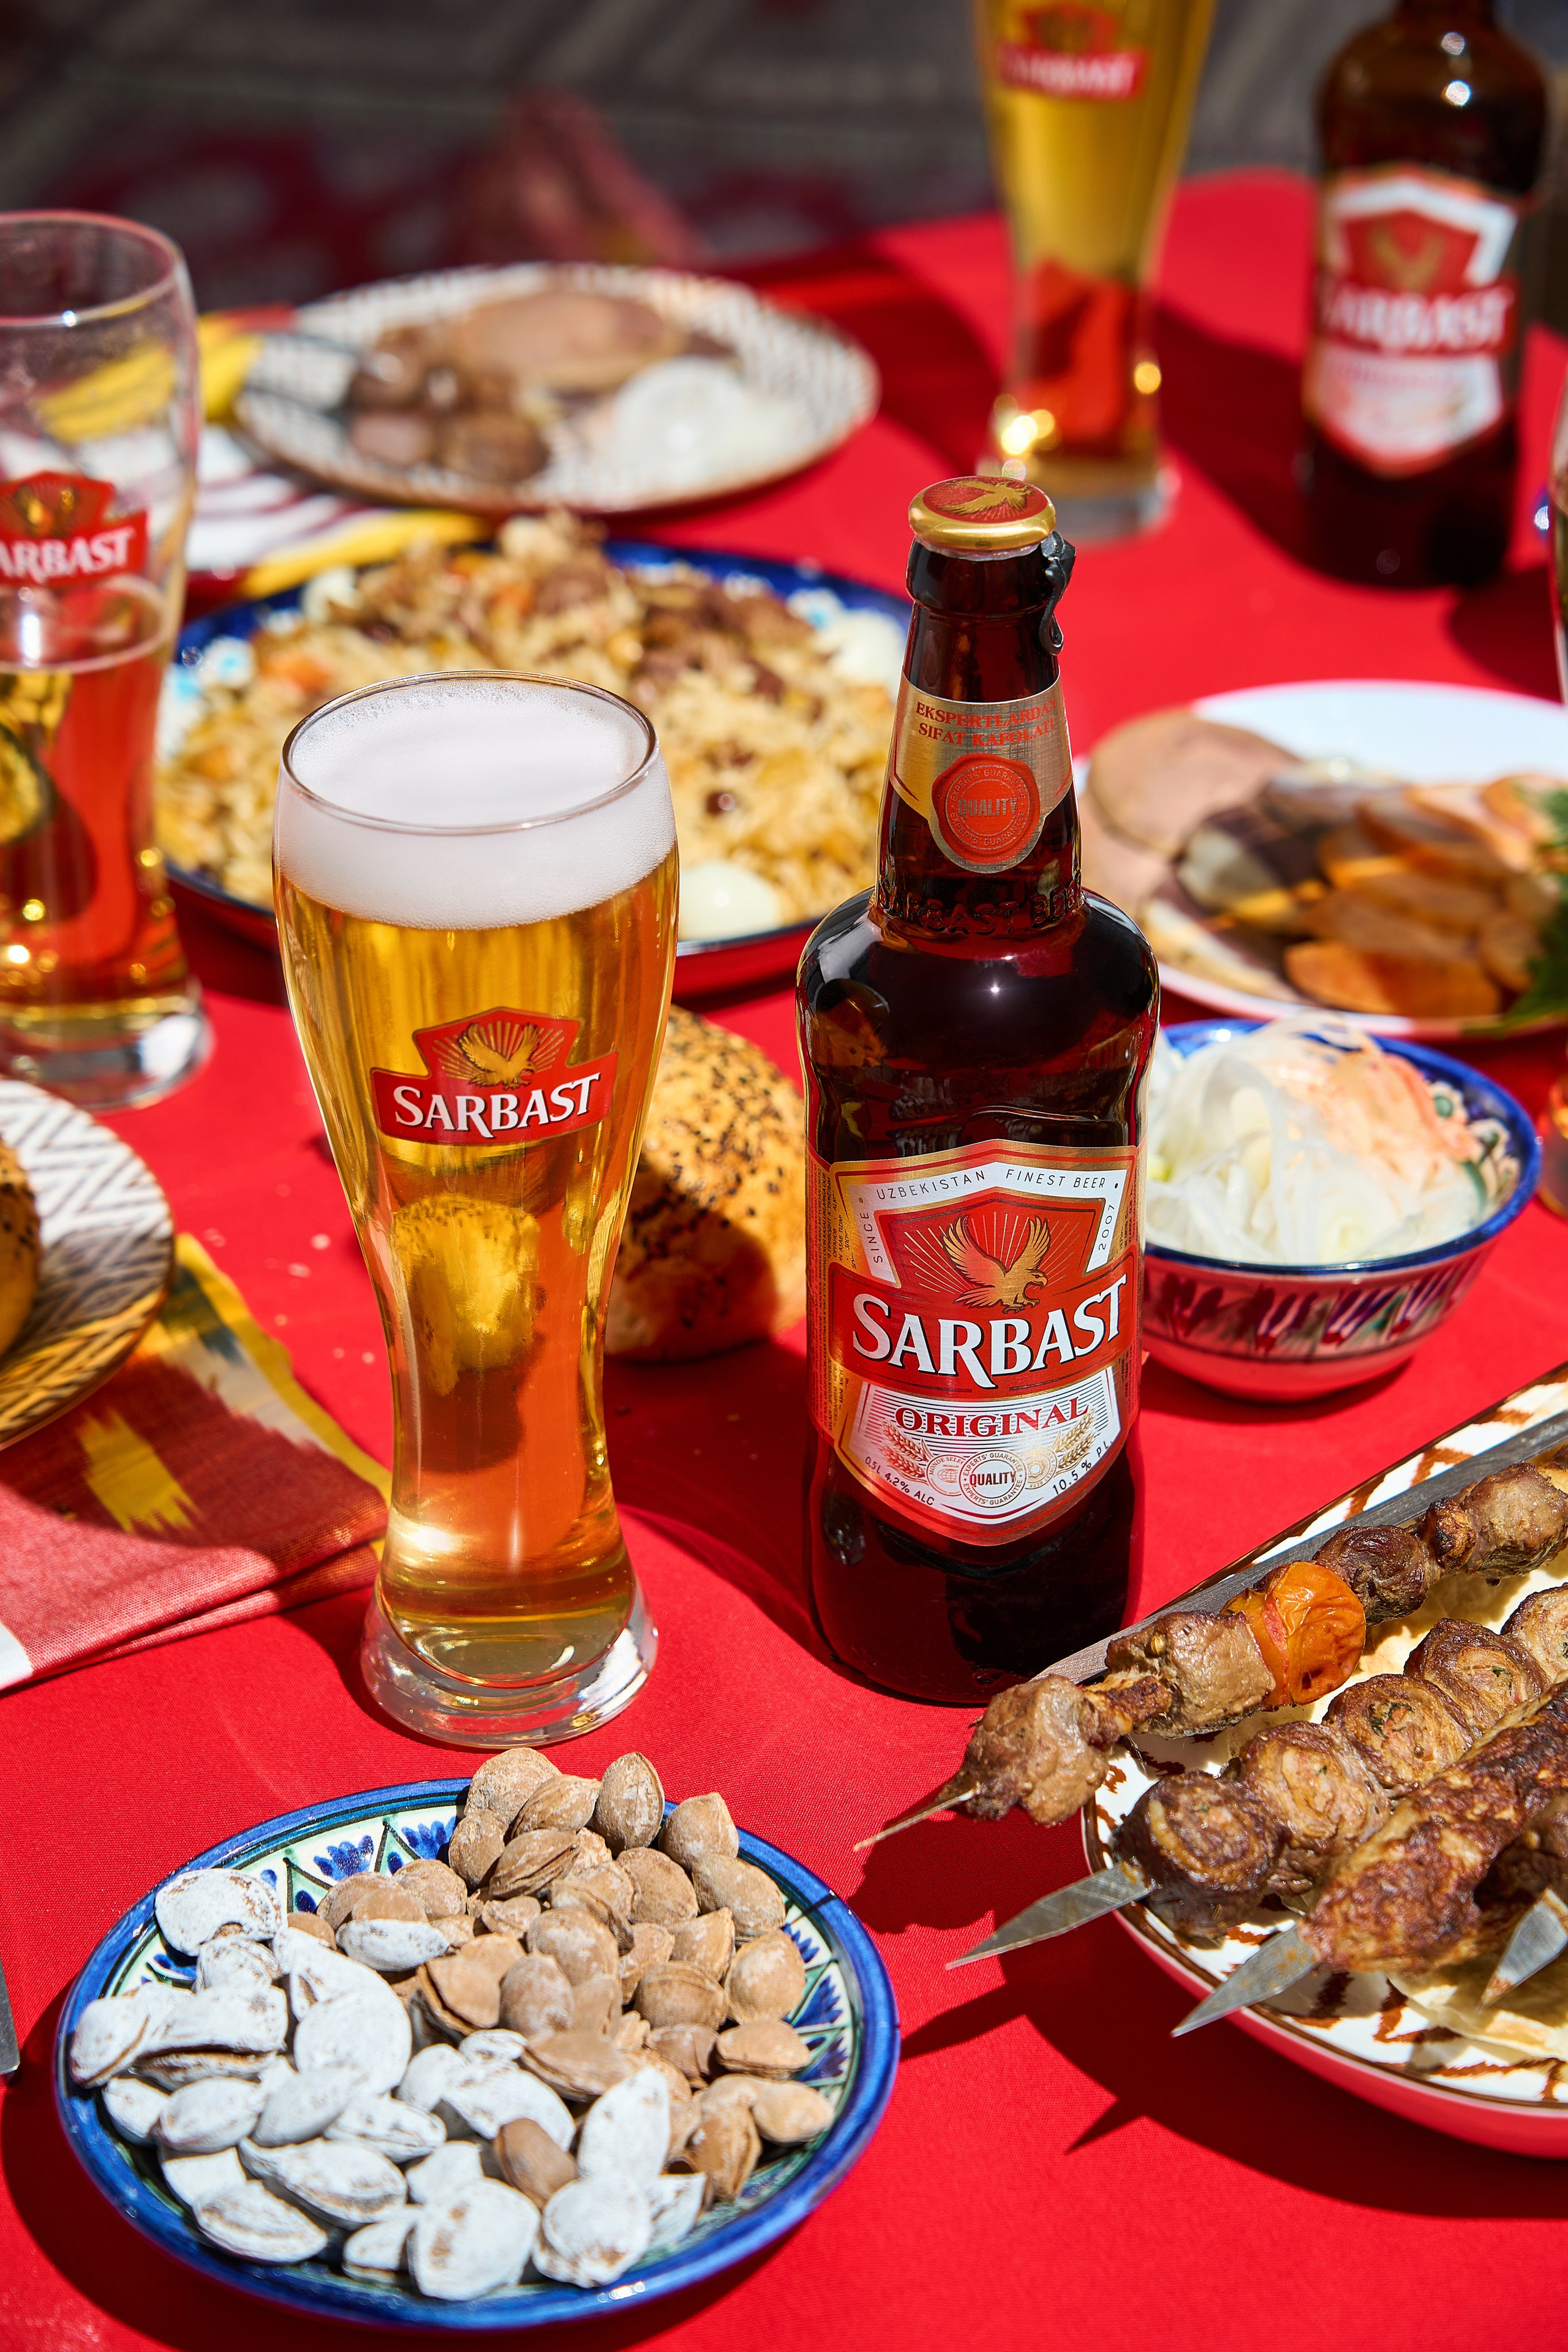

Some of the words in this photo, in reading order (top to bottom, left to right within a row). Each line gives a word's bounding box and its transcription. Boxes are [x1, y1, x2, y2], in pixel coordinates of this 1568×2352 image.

[915, 696, 1057, 729] EKSPERTLARDAN
[918, 723, 967, 745] SIFAT
[971, 717, 1055, 747] KAFOLATI
[984, 769, 1026, 799] GUARANTEE
[958, 797, 1017, 818] QUALITY
[984, 812, 1024, 845] GUARANTEE
[393, 1072, 600, 1138] SARBAST
[876, 1170, 985, 1200] UZBEKISTAN
[1006, 1169, 1066, 1186] FINEST
[1073, 1177, 1106, 1188] BEER
[859, 1213, 883, 1263] SINCE
[1098, 1205, 1115, 1250] 2007
[852, 1273, 1127, 1389] SARBAST
[895, 1398, 1090, 1436] ORIGINAL
[929, 1457, 945, 1476] MONDE
[963, 1454, 988, 1476] EXPERTS'
[990, 1452, 1023, 1472] GUARANTEE
[969, 1471, 1017, 1487] QUALITY
[884, 1472, 910, 1493] 4.2%
[913, 1490, 935, 1506] ALC
[963, 1483, 988, 1504] EXPERTS'
[989, 1479, 1023, 1505] GUARANTEE
